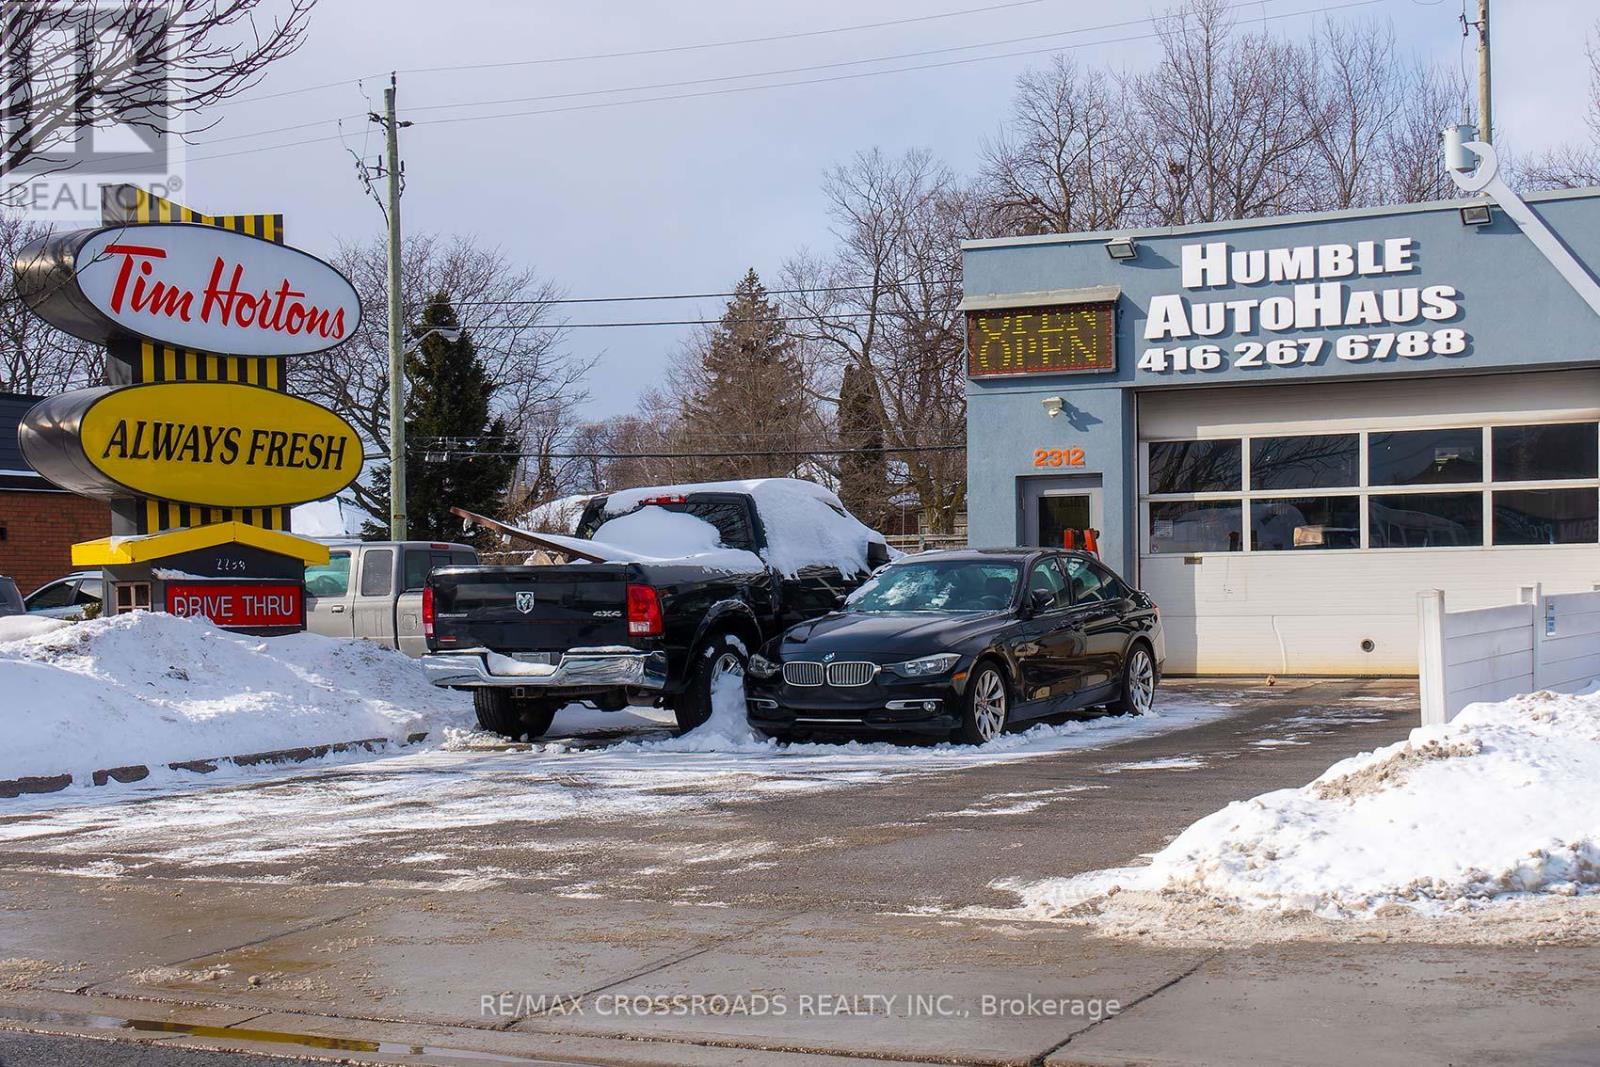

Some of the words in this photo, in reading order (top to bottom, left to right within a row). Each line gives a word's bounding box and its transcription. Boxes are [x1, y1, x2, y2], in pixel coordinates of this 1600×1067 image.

[1181, 237, 1413, 288] HUMBLE
[104, 244, 192, 323] Tim
[200, 256, 346, 340] Hortons
[1137, 344, 1221, 372] 416
[1233, 337, 1324, 368] 267
[1336, 328, 1467, 360] 6788
[102, 419, 242, 464] ALWAYS
[246, 429, 348, 471] FRESH
[1033, 447, 1086, 468] 2312
[173, 596, 233, 618] DRIVE
[241, 595, 294, 616] THRU
